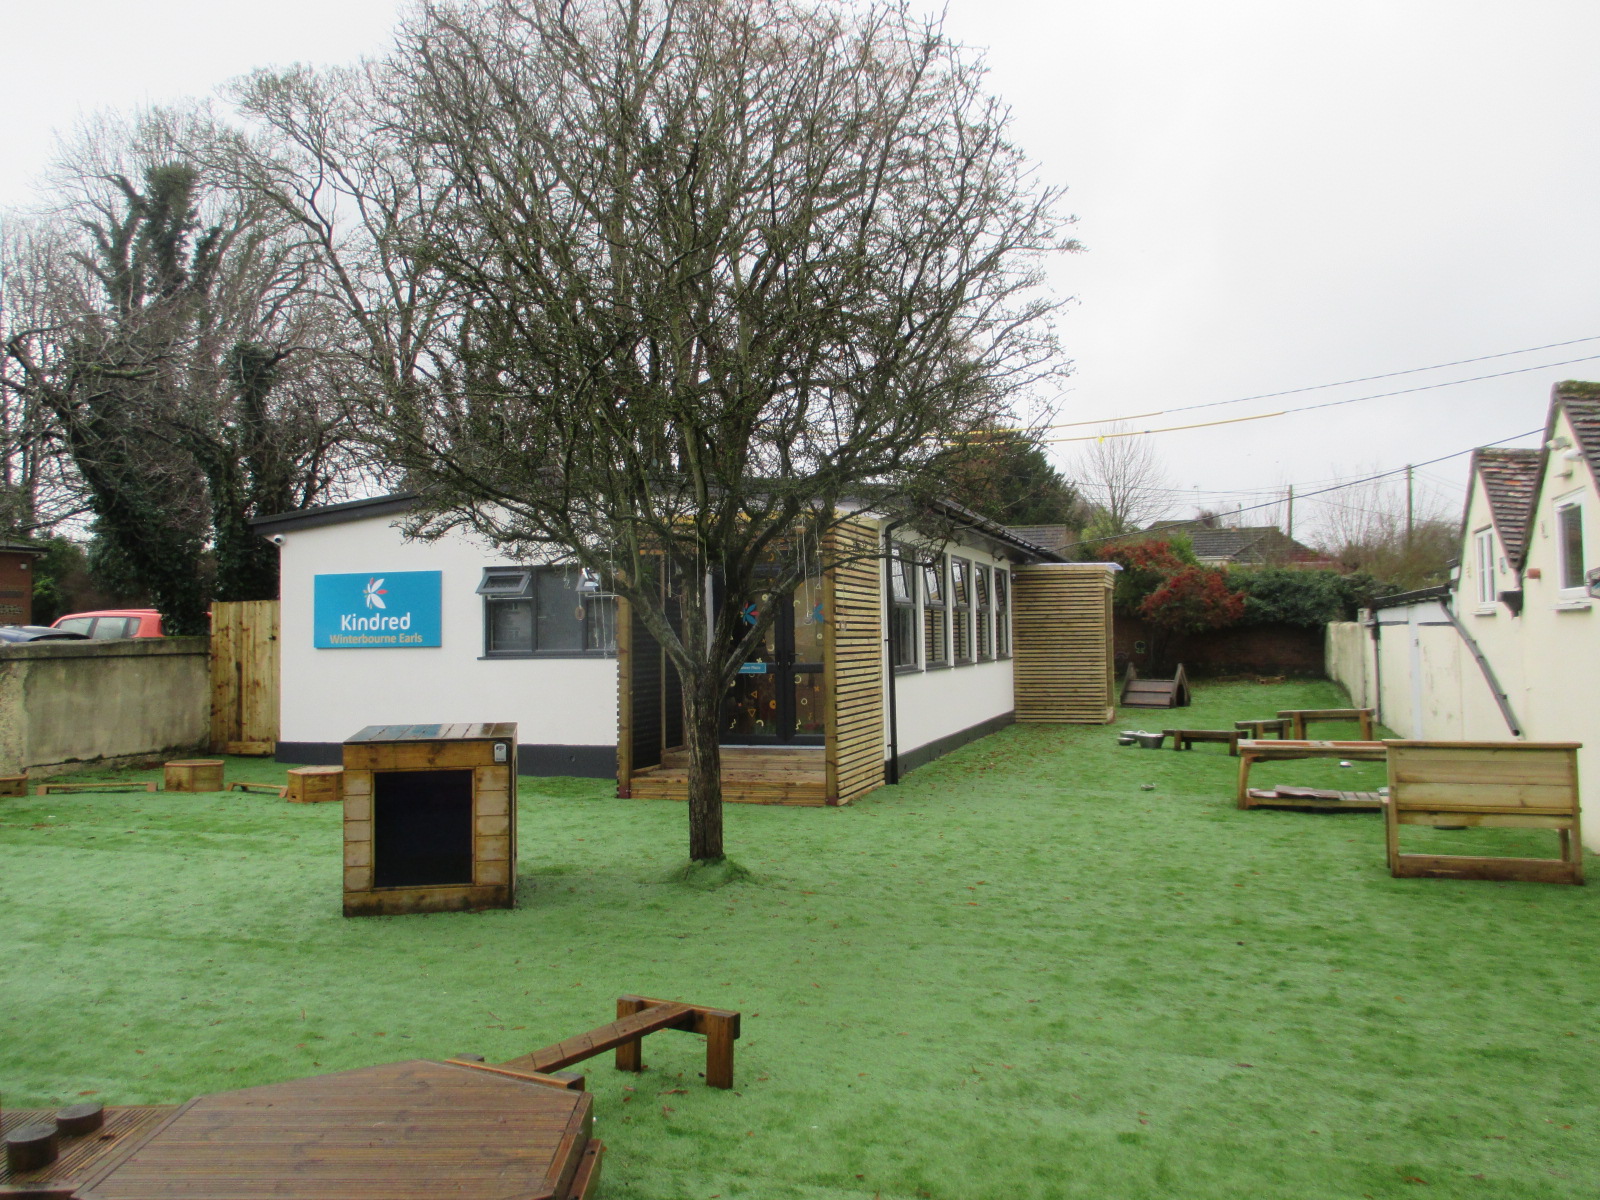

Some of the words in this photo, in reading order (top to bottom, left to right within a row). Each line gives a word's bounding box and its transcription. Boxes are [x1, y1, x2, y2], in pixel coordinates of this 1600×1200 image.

[341, 612, 411, 631] Kindred
[329, 633, 397, 644] Winterbourne
[399, 632, 423, 643] Earls
